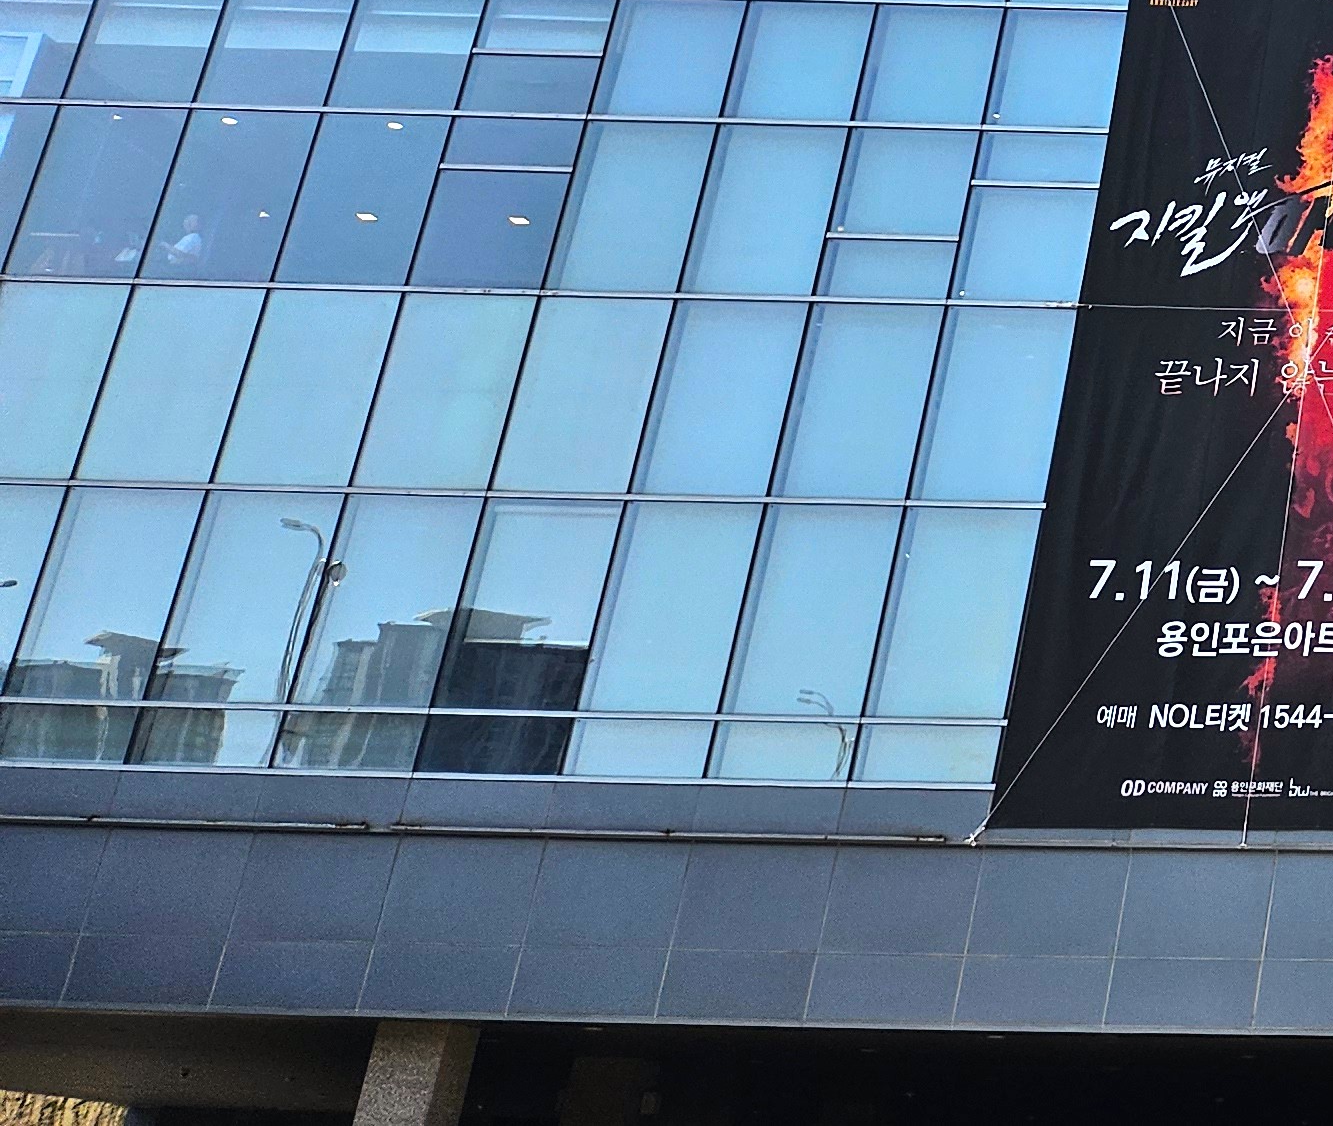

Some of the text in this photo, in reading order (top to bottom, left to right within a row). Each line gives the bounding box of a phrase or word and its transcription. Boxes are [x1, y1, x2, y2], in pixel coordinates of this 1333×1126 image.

[1194, 148, 1272, 194] 뮤지컬
[1218, 317, 1276, 348] 지금
[1289, 317, 1312, 343] 이
[1156, 359, 1257, 397] 끝나지
[1088, 559, 1240, 604] 7.11(금)
[1097, 706, 1136, 728] 예매
[1149, 703, 1251, 731] NOL티켓
[1121, 780, 1208, 796] OD COMPANY
[1231, 781, 1283, 792] 용인문화재단
